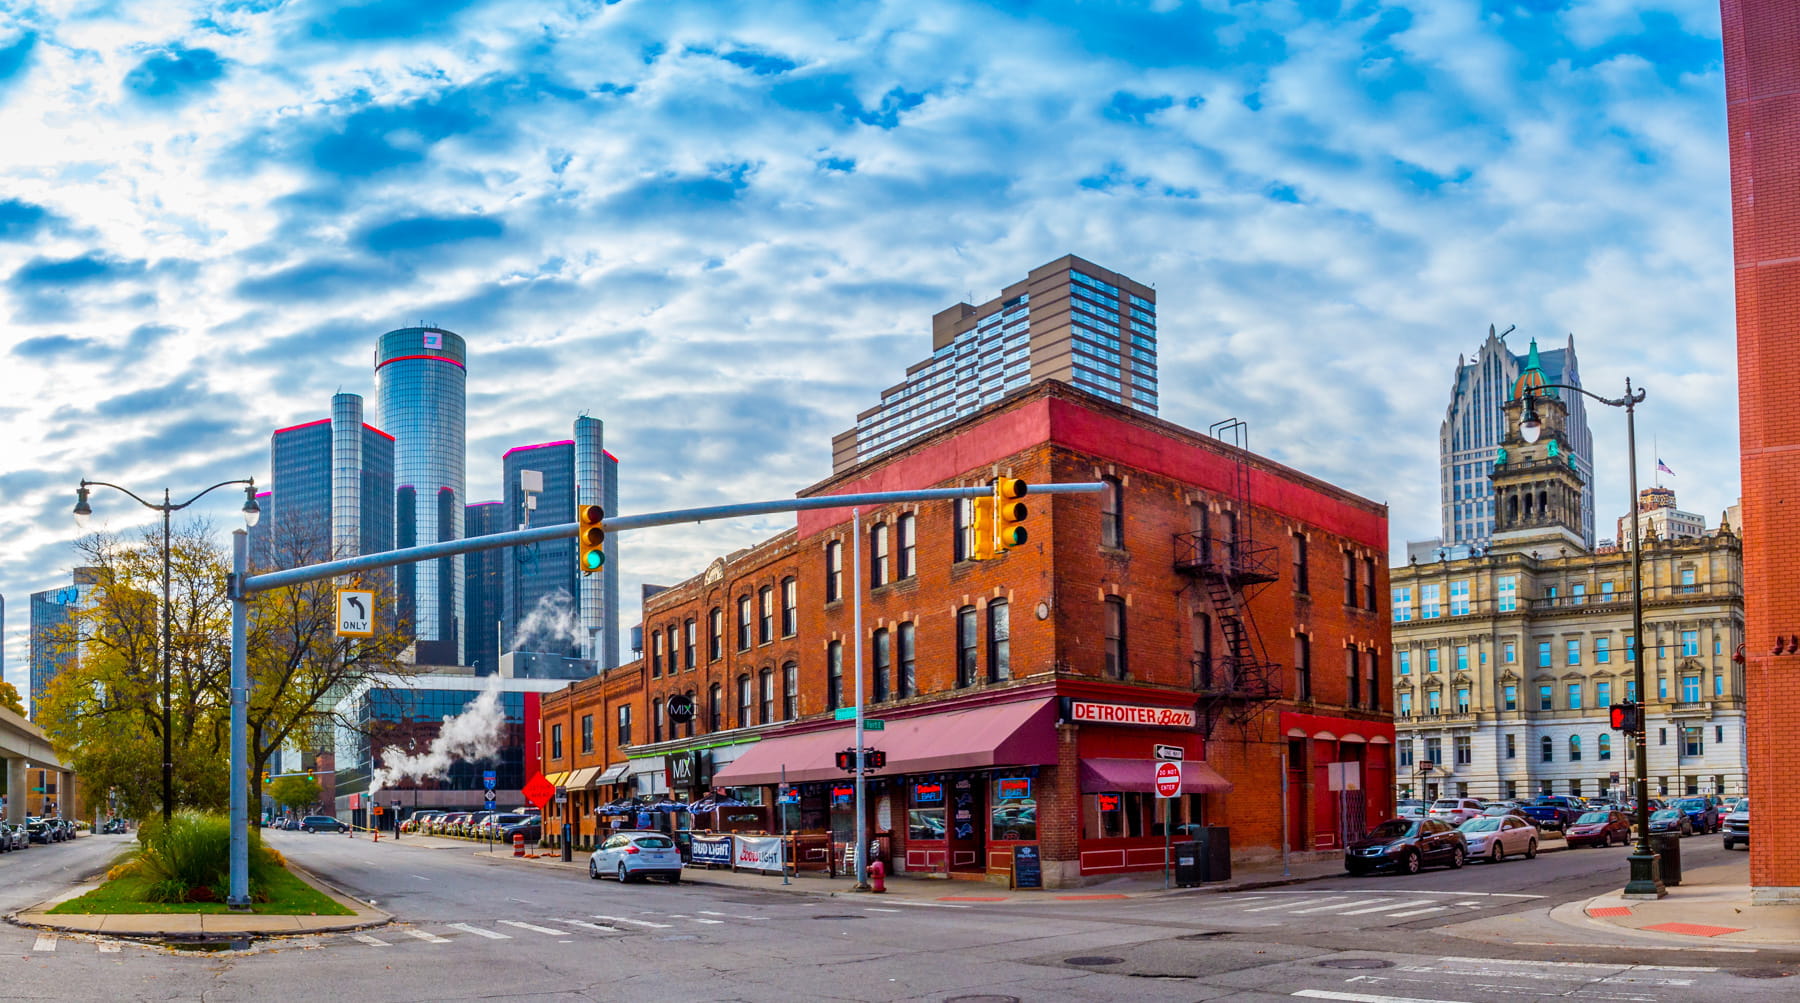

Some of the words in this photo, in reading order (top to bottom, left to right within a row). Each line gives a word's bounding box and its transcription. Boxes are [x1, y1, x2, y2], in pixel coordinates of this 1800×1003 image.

[343, 621, 367, 630] ONLY
[670, 704, 692, 715] MIX
[1075, 703, 1156, 723] DETROITER
[1158, 709, 1191, 725] Bar
[672, 757, 692, 779] MIX
[1167, 768, 1177, 776] NOT
[693, 842, 708, 855] BUD
[708, 843, 729, 856] LIGHT
[759, 850, 777, 864] LIGHT
